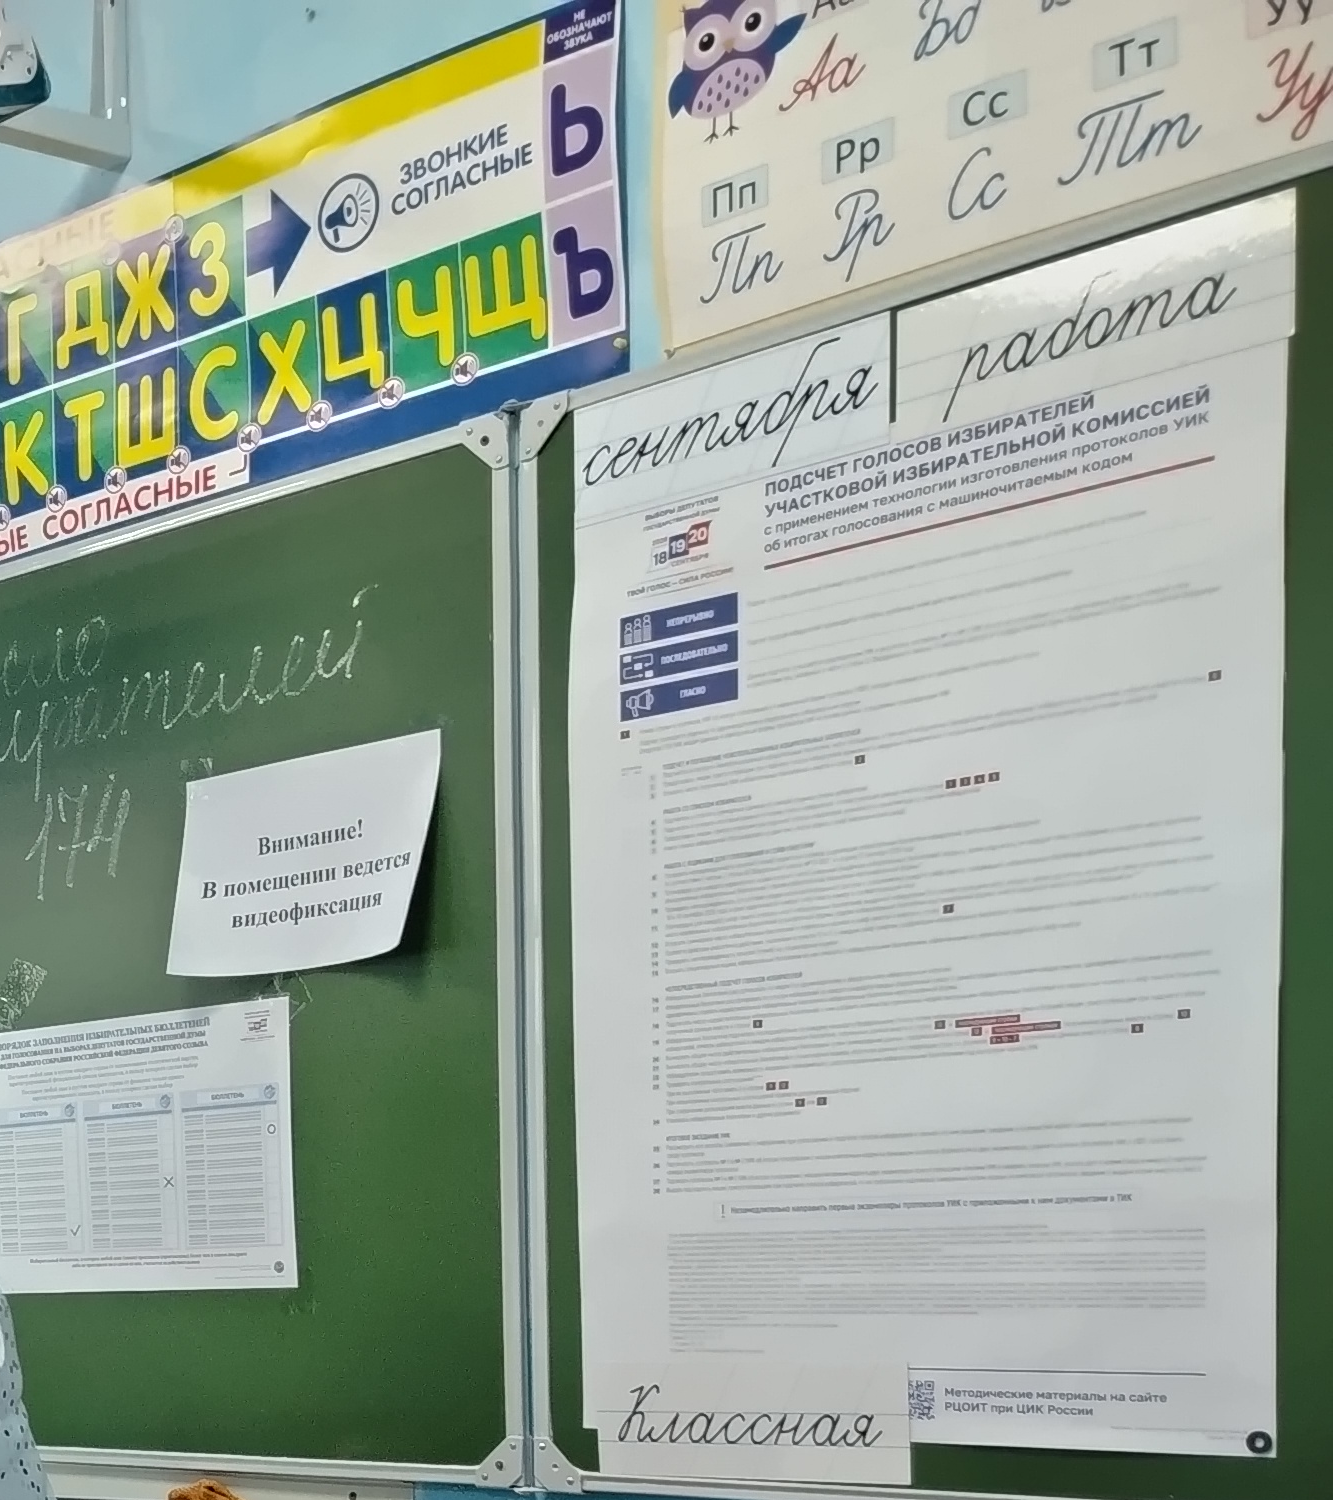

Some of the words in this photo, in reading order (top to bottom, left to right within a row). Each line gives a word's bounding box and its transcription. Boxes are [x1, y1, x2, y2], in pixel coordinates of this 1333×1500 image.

[547, 11, 613, 45] ОБОЗНАЧАЮТ
[563, 32, 594, 51] ЗВУКА
[573, 9, 586, 24] НЕ
[777, 34, 867, 114] Аа
[1108, 37, 1161, 79] Тт
[962, 88, 1009, 127] Сс
[1056, 89, 1202, 186] Тт
[391, 143, 534, 217] СОГЛАСНЫЕ
[399, 123, 509, 185] ЗВОНКИЕ
[835, 132, 881, 174] Рр
[947, 148, 1007, 221] Сс
[711, 181, 757, 218] Пп
[700, 222, 784, 305] Пп
[823, 187, 895, 282] Рр
[942, 269, 1238, 422] работа
[581, 337, 879, 487] сентября
[765, 462, 848, 496] ПОДСЧЕТ
[853, 437, 941, 472] ГОЛОСОВ
[948, 393, 1094, 447] ИЗБИРАТЕЛЕЙ
[765, 470, 887, 517] УЧАСТКОВОЙ
[893, 424, 1065, 484] ИЗБИРАТЕЛЬНОЙ
[1072, 387, 1209, 437] КОМИССИЕЙ
[776, 501, 868, 533] применением
[872, 479, 956, 507] технологии
[961, 450, 1067, 485] изготовления
[1072, 425, 1168, 457] протоколов
[1173, 412, 1208, 431] УИК
[42, 463, 217, 540] СОГЛАСНЫЕ
[764, 539, 780, 553] об
[784, 529, 828, 548] итогах
[832, 506, 922, 536] голосования
[939, 467, 1077, 509] машиночитаемым
[1082, 453, 1132, 473] кодом
[653, 551, 667, 566] 18
[671, 538, 686, 554] 19
[688, 527, 707, 543] 20
[257, 819, 364, 857] Внимание!
[202, 880, 217, 900] В
[223, 868, 337, 900] помещении
[341, 849, 411, 881] ведется
[231, 890, 382, 929] видеофиксация
[616, 1383, 883, 1448] Классная
[944, 1387, 1033, 1400] Методические
[1036, 1392, 1106, 1402] материалы
[1129, 1391, 1168, 1403] сайте
[944, 1401, 988, 1413] РЦОИТ
[991, 1405, 1013, 1415] при
[1017, 1404, 1044, 1414] ЦИК
[1048, 1405, 1093, 1415] России
